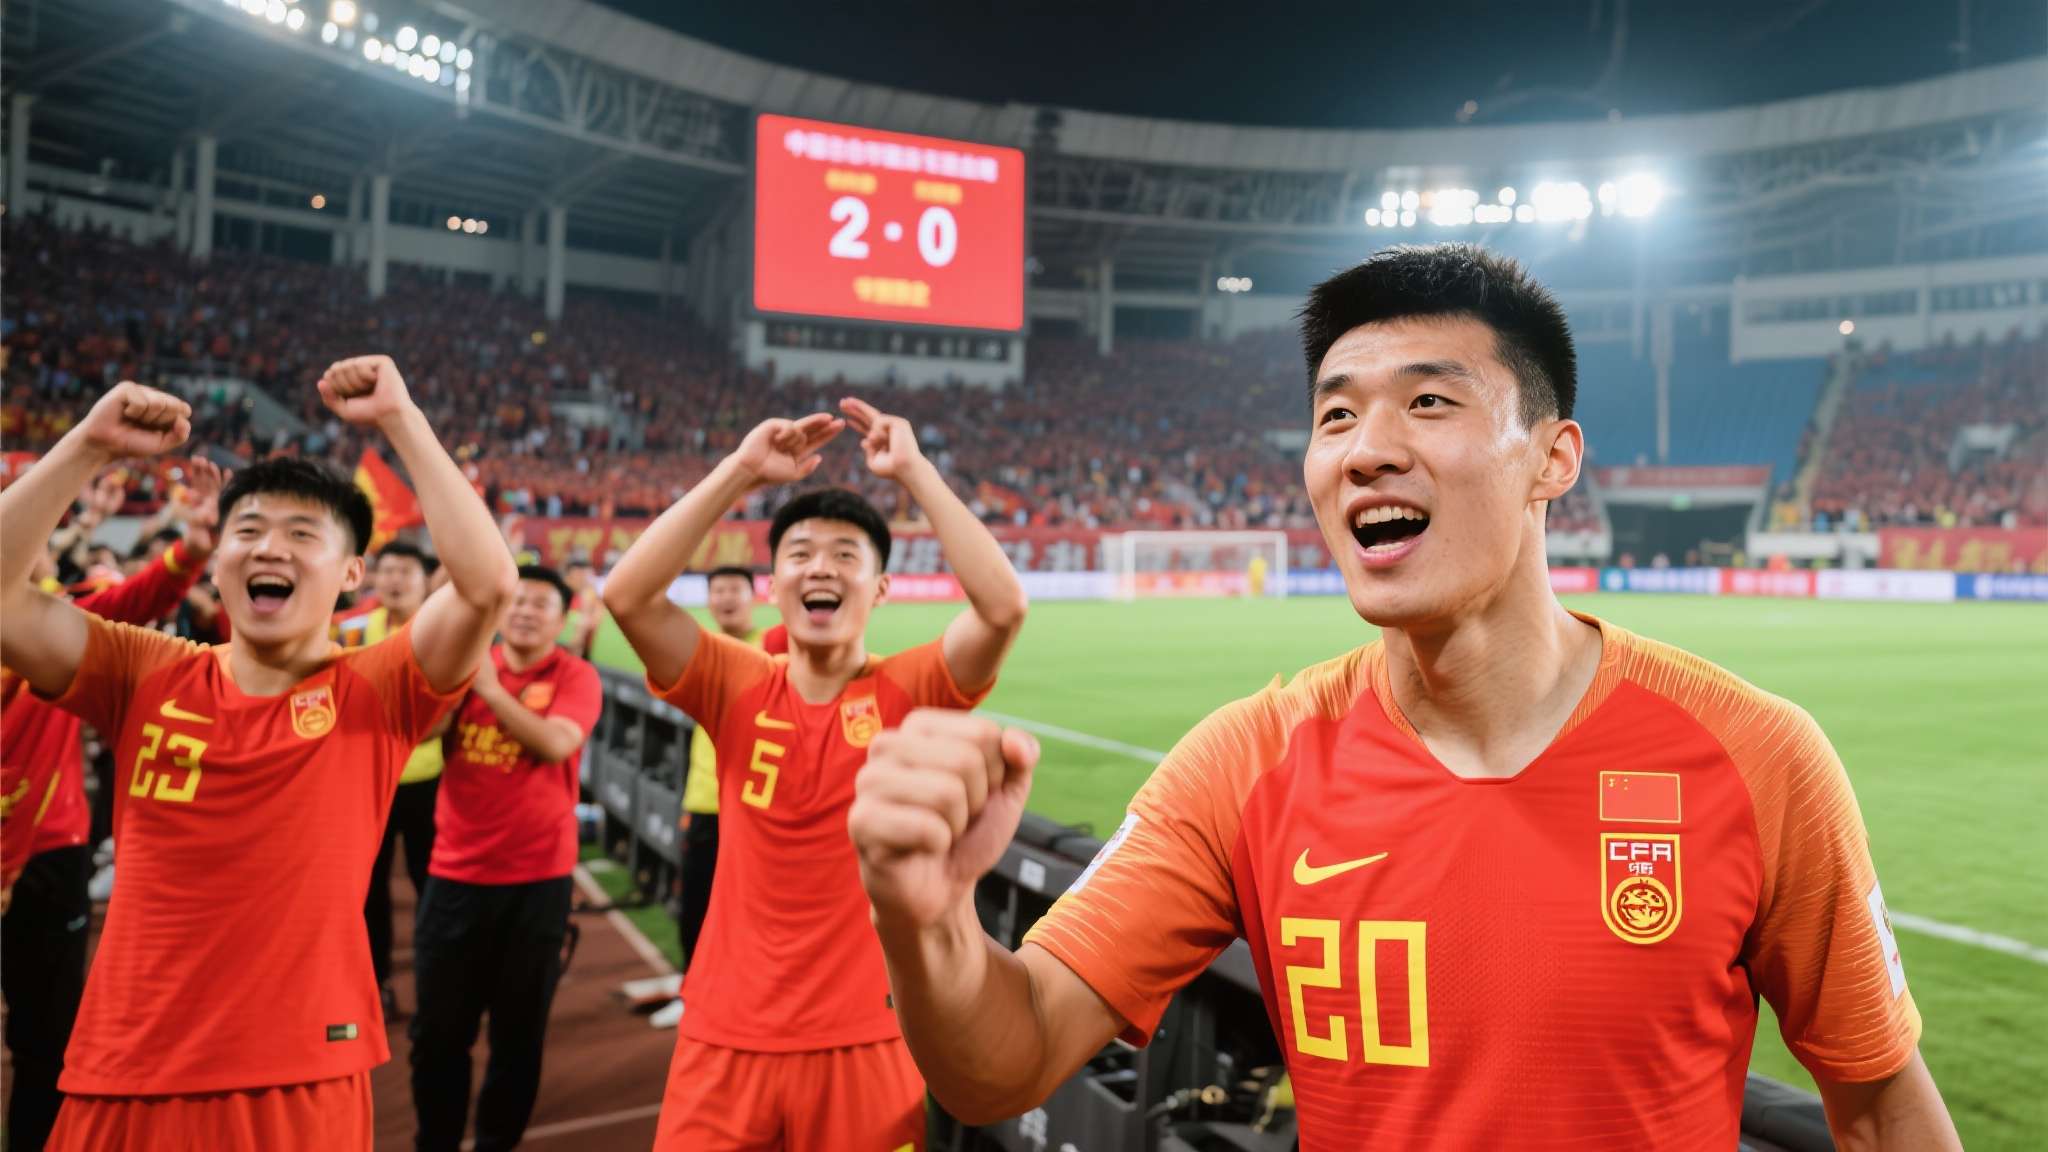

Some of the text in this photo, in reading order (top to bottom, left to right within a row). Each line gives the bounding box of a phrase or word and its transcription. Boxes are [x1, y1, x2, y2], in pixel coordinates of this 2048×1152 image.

[129, 722, 208, 802] 23
[741, 738, 786, 809] 5
[1609, 842, 1672, 862] CFA
[1281, 917, 1430, 1067] 20
